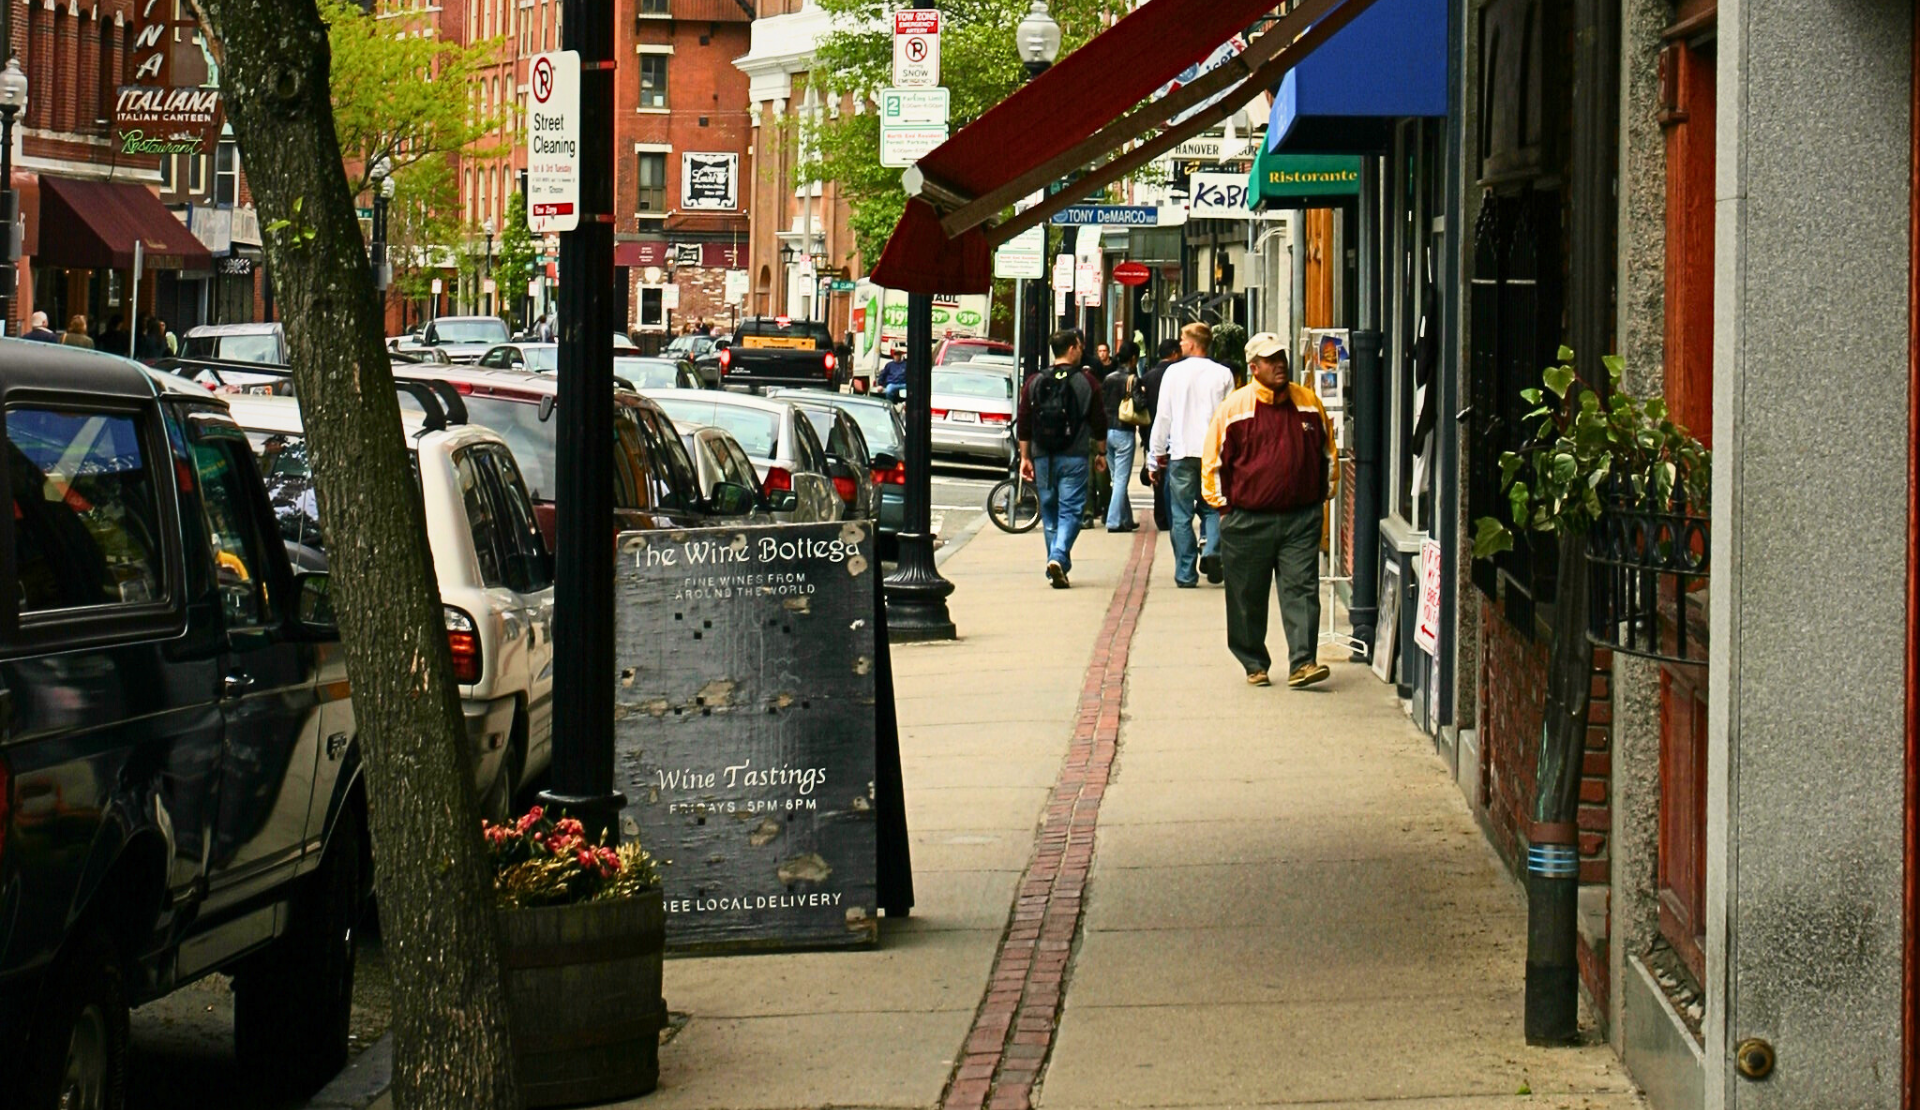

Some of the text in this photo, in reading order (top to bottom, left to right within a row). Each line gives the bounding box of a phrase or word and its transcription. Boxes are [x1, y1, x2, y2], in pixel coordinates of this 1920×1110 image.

[897, 12, 937, 21] TOW ZONE
[902, 69, 929, 77] SNOW
[116, 89, 219, 113] ITALIANA
[888, 98, 899, 110] 2
[117, 113, 211, 122] ITALIAN CANTEEN
[534, 112, 564, 131] Street
[119, 129, 203, 156] Restaurant
[533, 135, 576, 158] Cleaning
[1175, 143, 1219, 156] HANOVER
[555, 164, 572, 174] Tuesday
[1269, 169, 1358, 184] Ristorante
[535, 205, 544, 214] Tow
[1068, 209, 1094, 223] TONY
[1097, 209, 1146, 223] DeMARCO
[633, 536, 860, 568] The Wine Bottega
[684, 572, 806, 588] FINE WINES FROM
[675, 583, 816, 601] AROUND THE WORLD
[656, 758, 827, 795] Wine Tastings
[696, 897, 753, 912] LOCAL
[756, 892, 842, 908] DELIVERY
